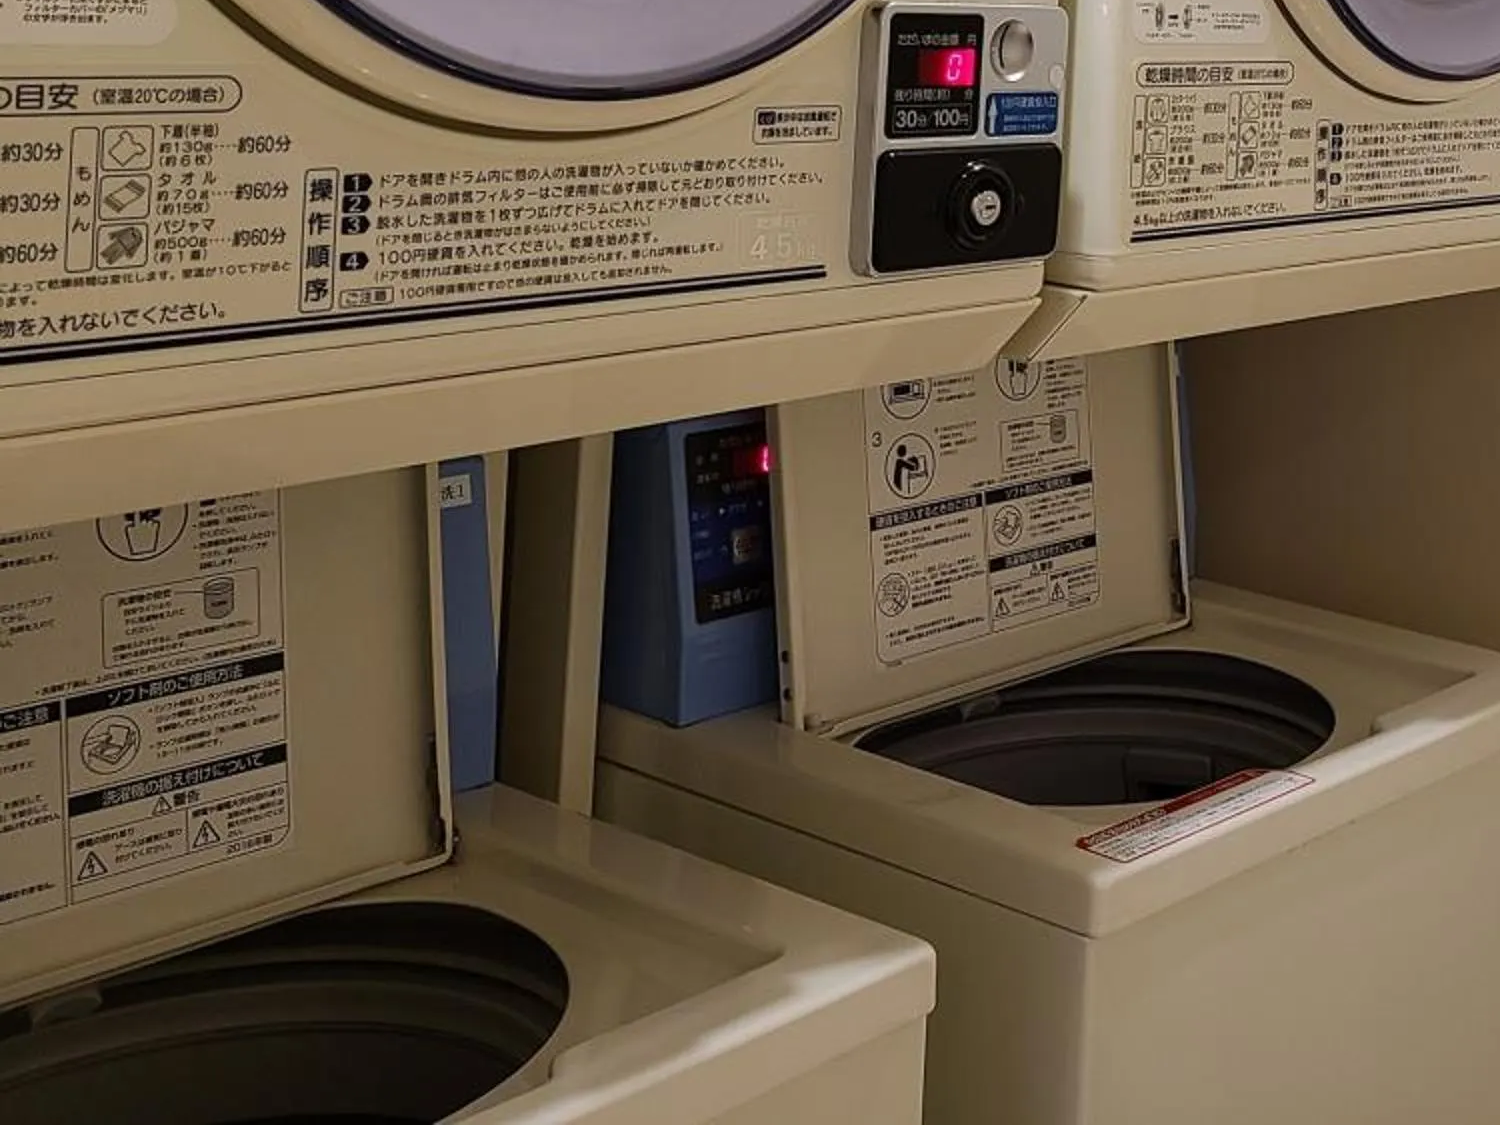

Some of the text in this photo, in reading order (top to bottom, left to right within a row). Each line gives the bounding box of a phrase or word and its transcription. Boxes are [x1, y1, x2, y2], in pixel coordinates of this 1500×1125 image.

[946, 53, 962, 81] 0
[1, 142, 63, 161] 約30分
[237, 136, 291, 153] 約60分
[158, 174, 216, 186] タオル
[72, 167, 91, 233] もめん
[235, 182, 288, 200] 約60分
[0, 193, 60, 212] 約30分
[154, 218, 215, 235] パジャマ
[232, 228, 286, 247] 約60分
[304, 178, 333, 302] 操作順序
[871, 432, 882, 447] 3
[441, 484, 464, 500] 洗1
